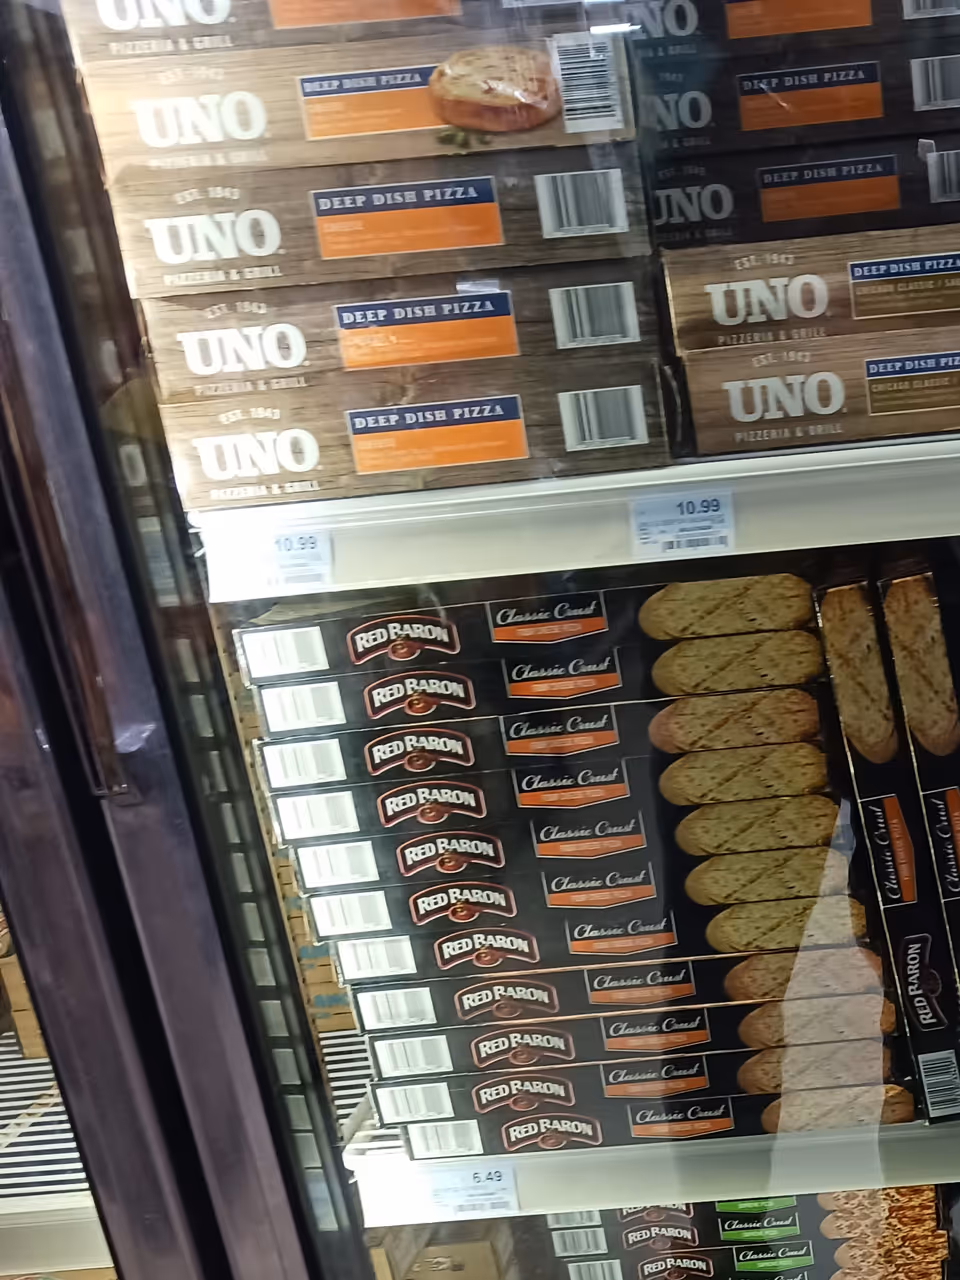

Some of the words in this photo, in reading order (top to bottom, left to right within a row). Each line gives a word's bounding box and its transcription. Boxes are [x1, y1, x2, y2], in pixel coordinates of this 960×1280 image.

[303, 80, 340, 92] DEEP
[343, 76, 376, 89] DISH
[381, 73, 422, 86] PIZZA
[744, 78, 779, 91] DEEP
[784, 74, 818, 86] DISH
[824, 70, 865, 83] PIZZA
[129, 91, 267, 148] UNO
[764, 171, 798, 184] DEEP
[804, 167, 837, 179] DISH
[842, 163, 883, 176] PIZZA
[319, 196, 366, 210] DEEP
[372, 190, 417, 205] DISH
[423, 186, 478, 201] PIZZA
[143, 209, 282, 264] UNO
[854, 266, 887, 277] DEEP
[890, 262, 921, 272] DISH
[704, 274, 828, 326] UNO
[342, 309, 387, 324] DEEP
[393, 305, 436, 319] DISH
[441, 301, 495, 315] PIZZA
[177, 323, 307, 375] UNO
[869, 362, 902, 374] DEEP
[905, 358, 936, 370] DISH
[721, 371, 845, 422] UNO
[354, 414, 400, 429] DEEP
[405, 410, 448, 424] DISH
[452, 405, 504, 419] PIZZA
[191, 429, 320, 480] UNO
[676, 499, 721, 515] 10.99
[274, 535, 317, 552] 10.99
[496, 608, 551, 625] Classic
[553, 600, 597, 618] Crust
[354, 628, 388, 652] RED
[388, 623, 449, 643] BARON
[868, 805, 890, 845] Crust
[551, 876, 602, 891] Classic
[605, 870, 647, 887] Crust
[885, 851, 901, 899] Classic
[417, 892, 448, 915] RED
[448, 888, 506, 907] BARON
[593, 975, 644, 989] Classic
[646, 969, 687, 985] Crust
[907, 943, 924, 996] BARON
[462, 989, 492, 1010] RED
[492, 985, 549, 1003] BARON
[916, 998, 937, 1025] RED
[636, 1110, 684, 1123] Classic
[687, 1104, 726, 1119] Crust
[509, 1122, 538, 1142] RED
[538, 1118, 593, 1136] BARON
[472, 1170, 503, 1184] 6.49
[739, 1250, 777, 1261] Classic
[778, 1246, 807, 1258] Crust
[643, 1261, 665, 1275] RED
[666, 1258, 706, 1270] BARON
